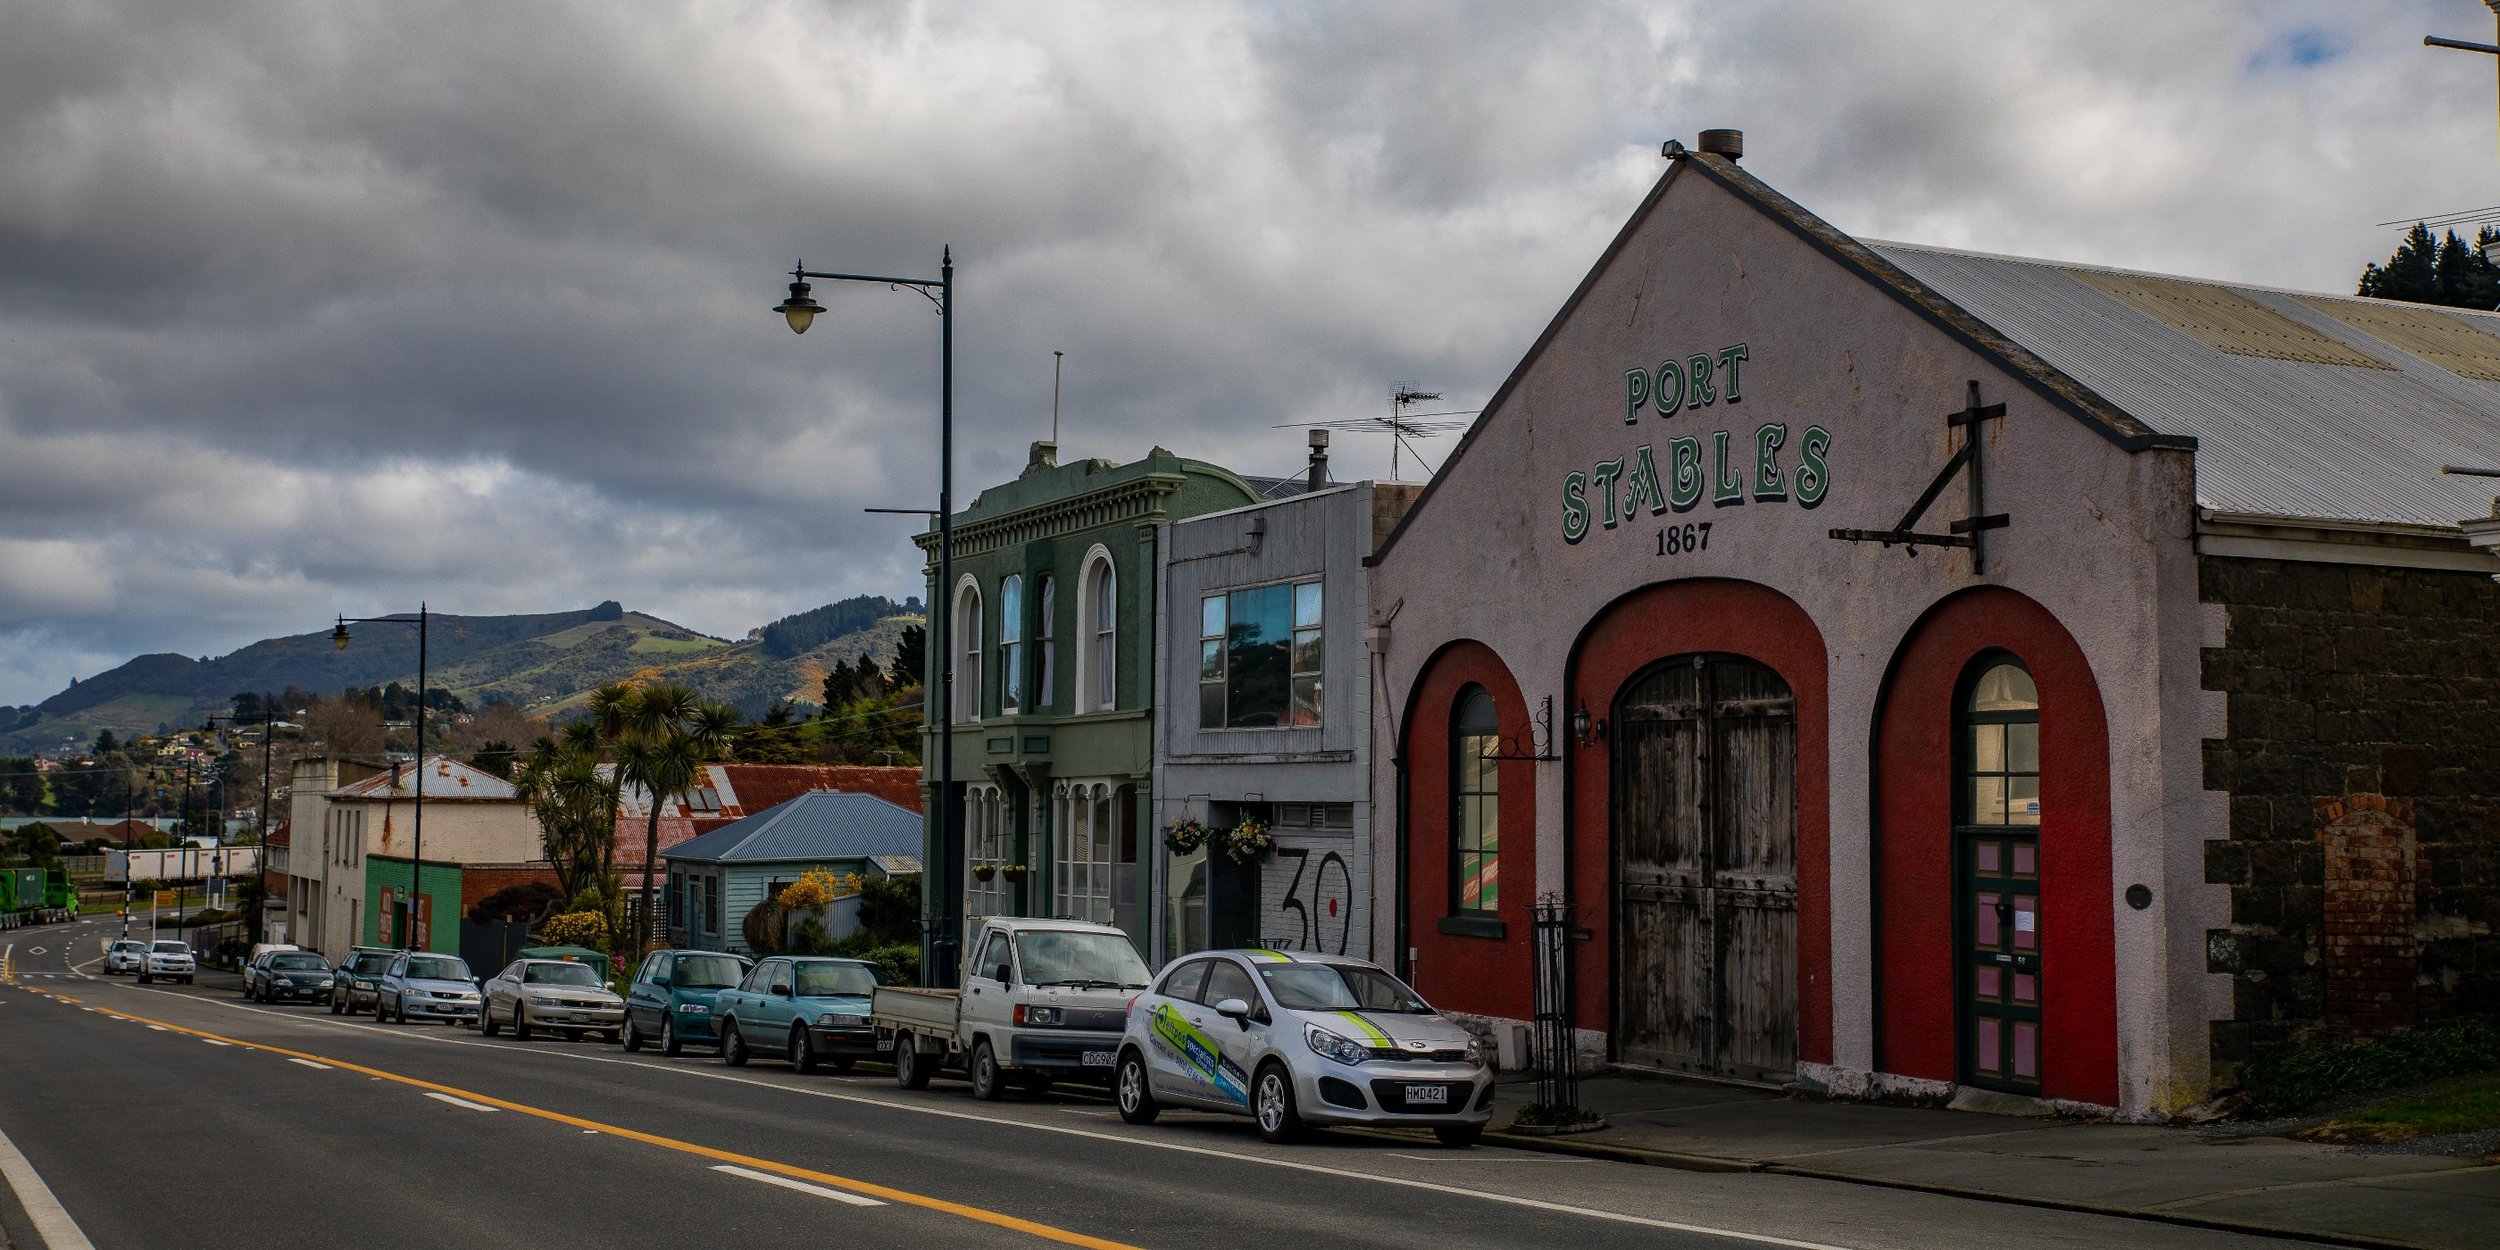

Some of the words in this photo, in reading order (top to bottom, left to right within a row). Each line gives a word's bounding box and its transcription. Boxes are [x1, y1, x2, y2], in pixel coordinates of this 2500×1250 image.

[1624, 343, 1749, 425] PORT
[1561, 423, 1832, 545] STABLES
[1656, 522, 1713, 556] 1867
[1278, 847, 1353, 957] 30
[1166, 1020, 1186, 1045] eftpos
[1187, 1039, 1215, 1068] specialists
[1407, 1088, 1445, 1100] HMD421
